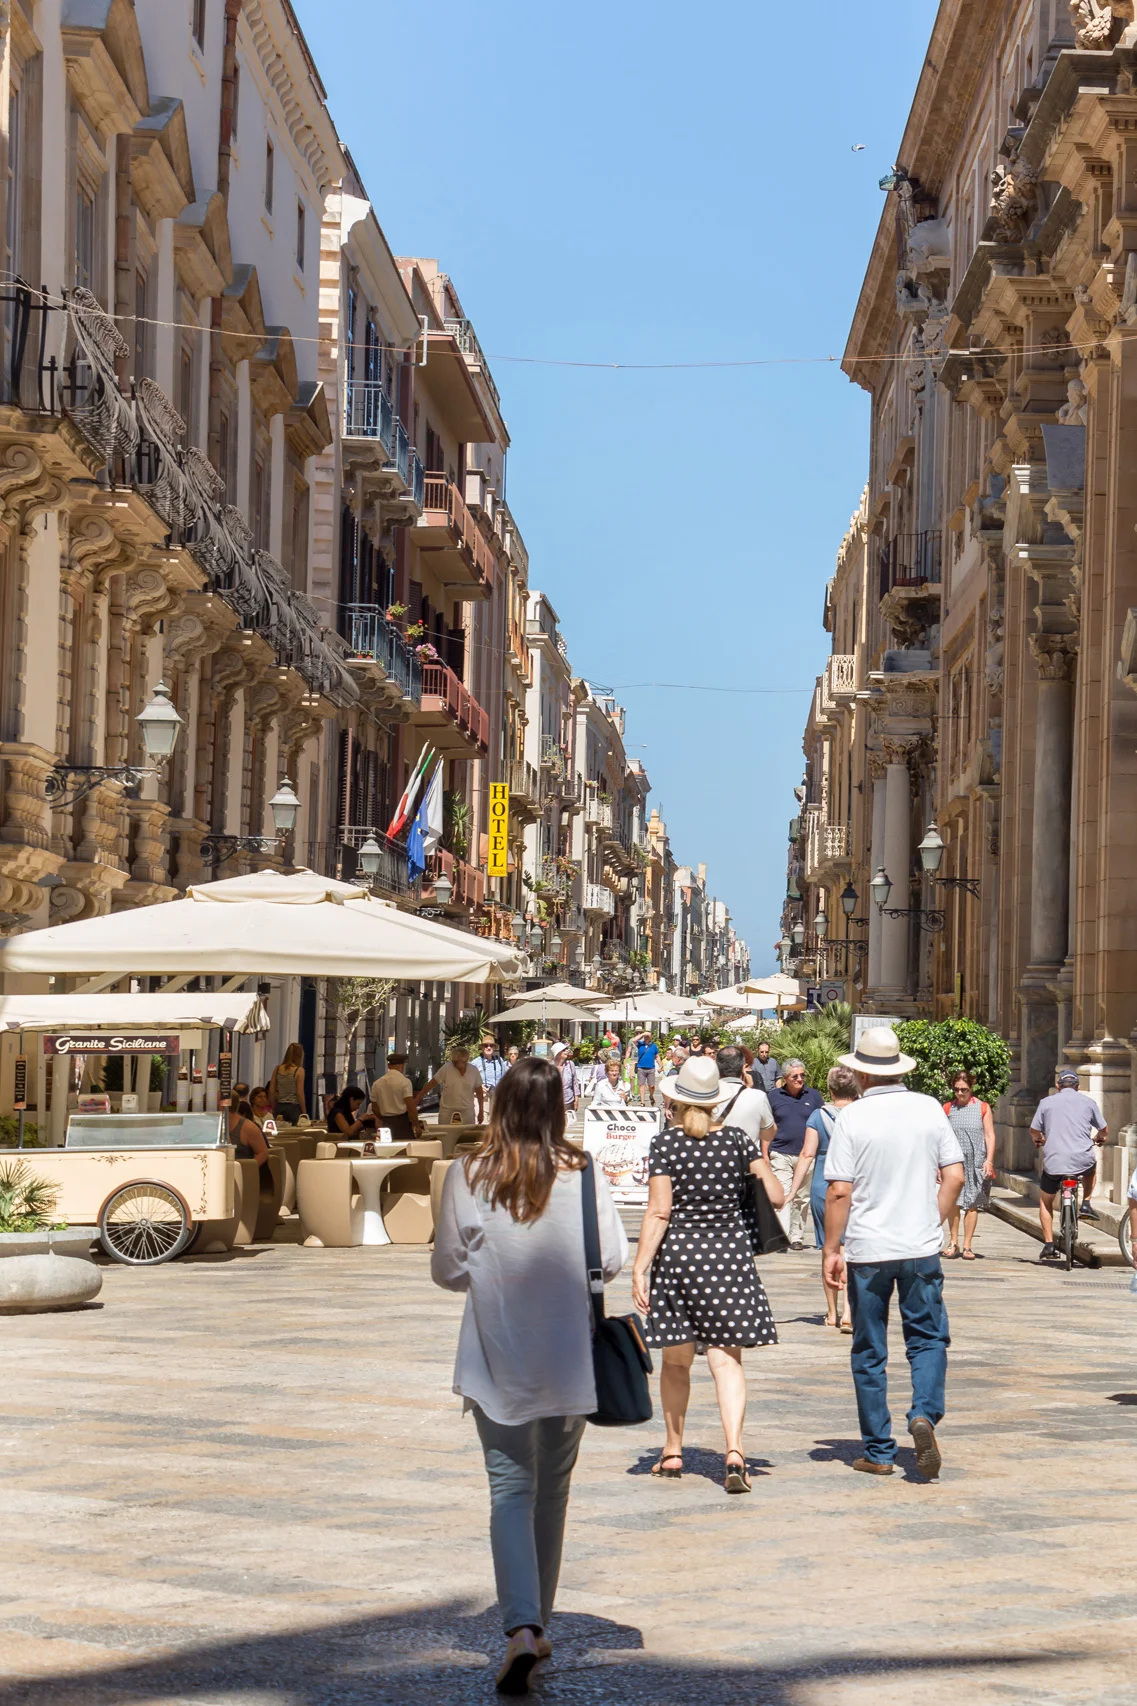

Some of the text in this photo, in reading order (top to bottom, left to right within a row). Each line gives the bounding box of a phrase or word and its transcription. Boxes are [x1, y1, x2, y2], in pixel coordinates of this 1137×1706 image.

[492, 785, 507, 867] HOTEL
[55, 1037, 167, 1054] Granite Siciliane
[607, 1123, 636, 1131] Choco
[606, 1132, 636, 1141] Burger
